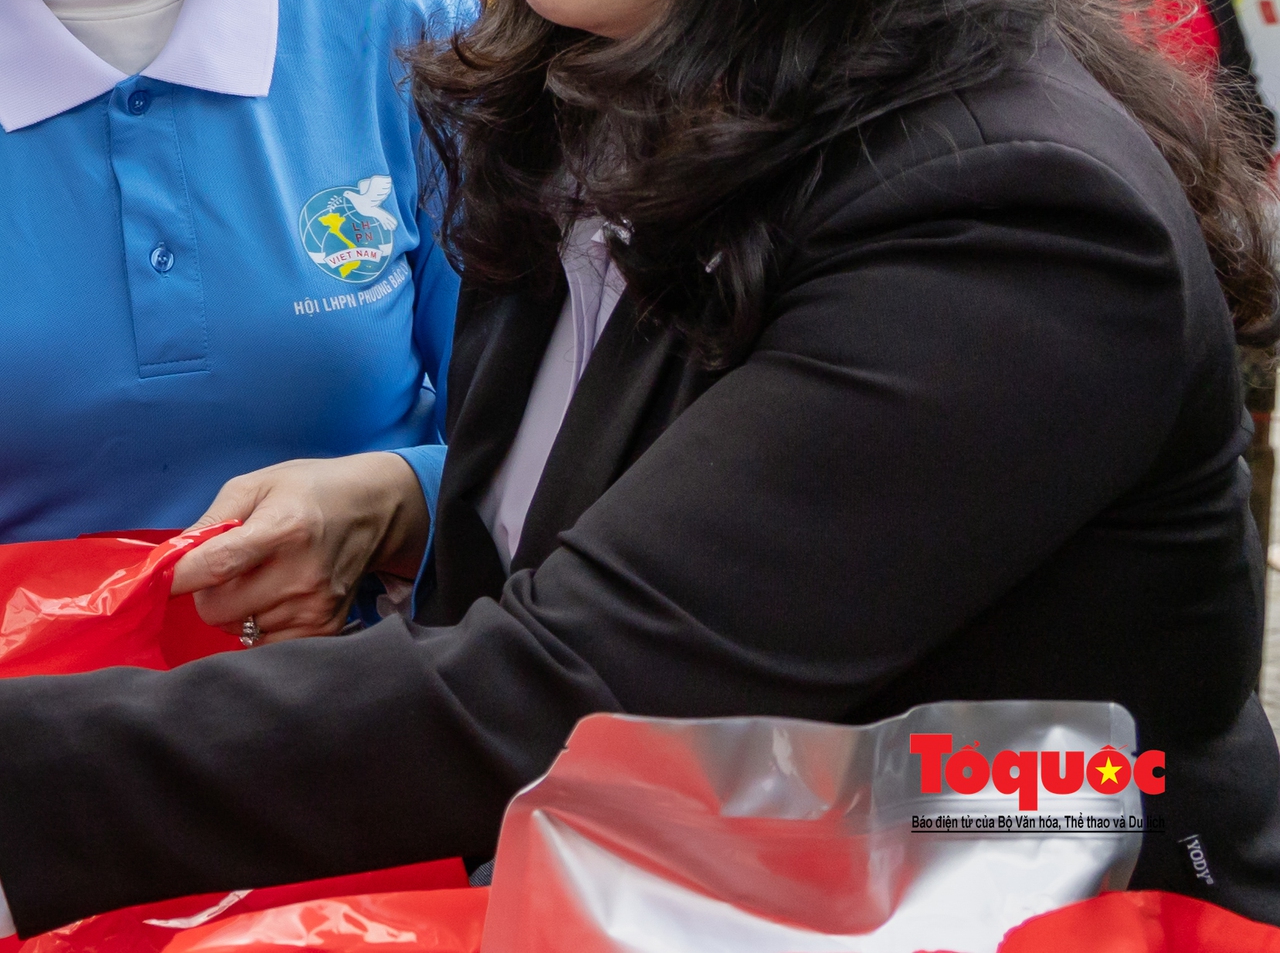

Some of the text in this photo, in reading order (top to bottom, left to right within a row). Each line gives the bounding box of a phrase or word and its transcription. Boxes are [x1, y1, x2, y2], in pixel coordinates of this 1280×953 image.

[329, 250, 377, 265] VIET NAM
[294, 297, 320, 317] HỘI
[322, 293, 357, 312] LHPN
